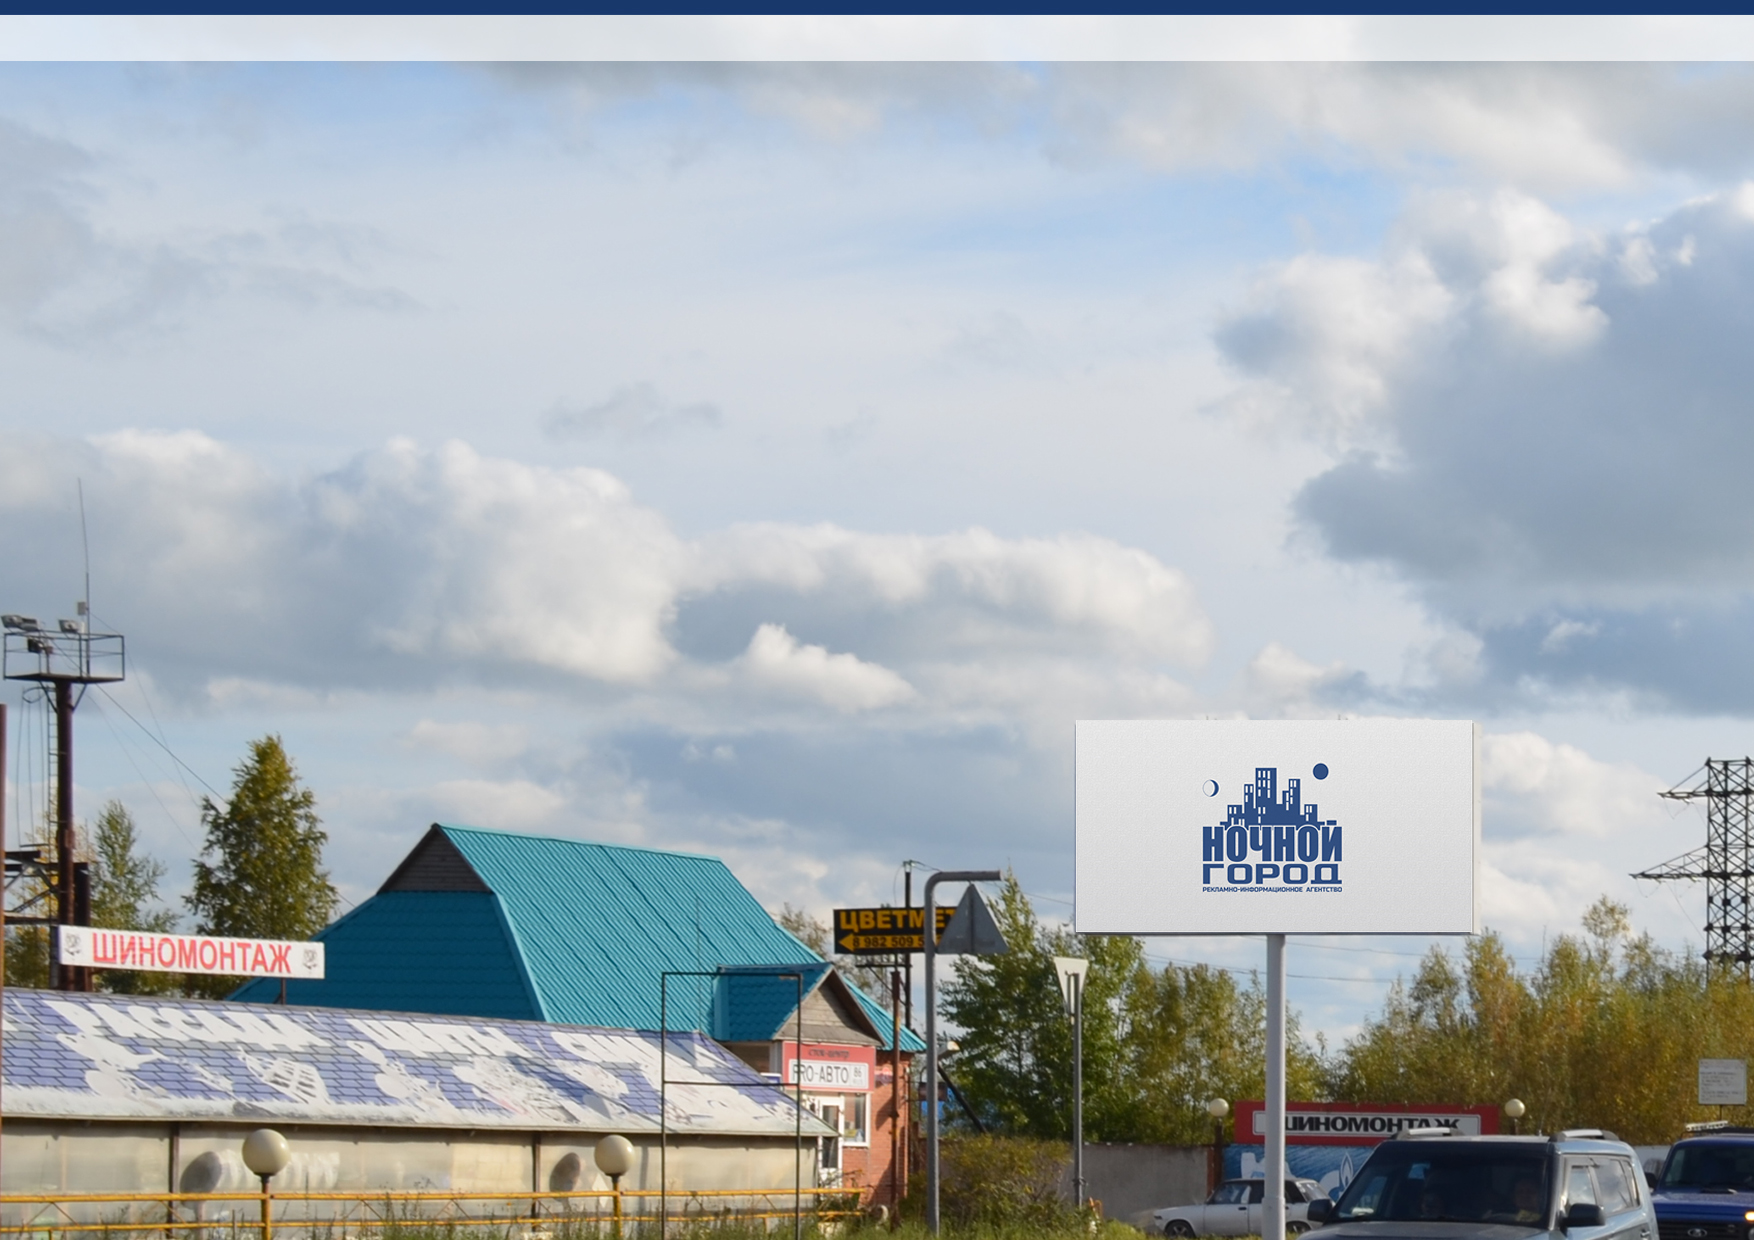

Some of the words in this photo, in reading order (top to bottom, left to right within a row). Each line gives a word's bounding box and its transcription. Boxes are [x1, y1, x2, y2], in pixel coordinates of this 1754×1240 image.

[1202, 820, 1343, 862] НОЧНОЙ
[1202, 863, 1343, 885] ГОРОД
[1202, 886, 1303, 894] РЕКЛАМНО-ИНФОРМАЦИОННОЕ
[853, 936, 861, 948] 8
[864, 936, 887, 948] 982
[891, 935, 914, 948] 509
[92, 932, 292, 974] ШИНОМОНТАЖ
